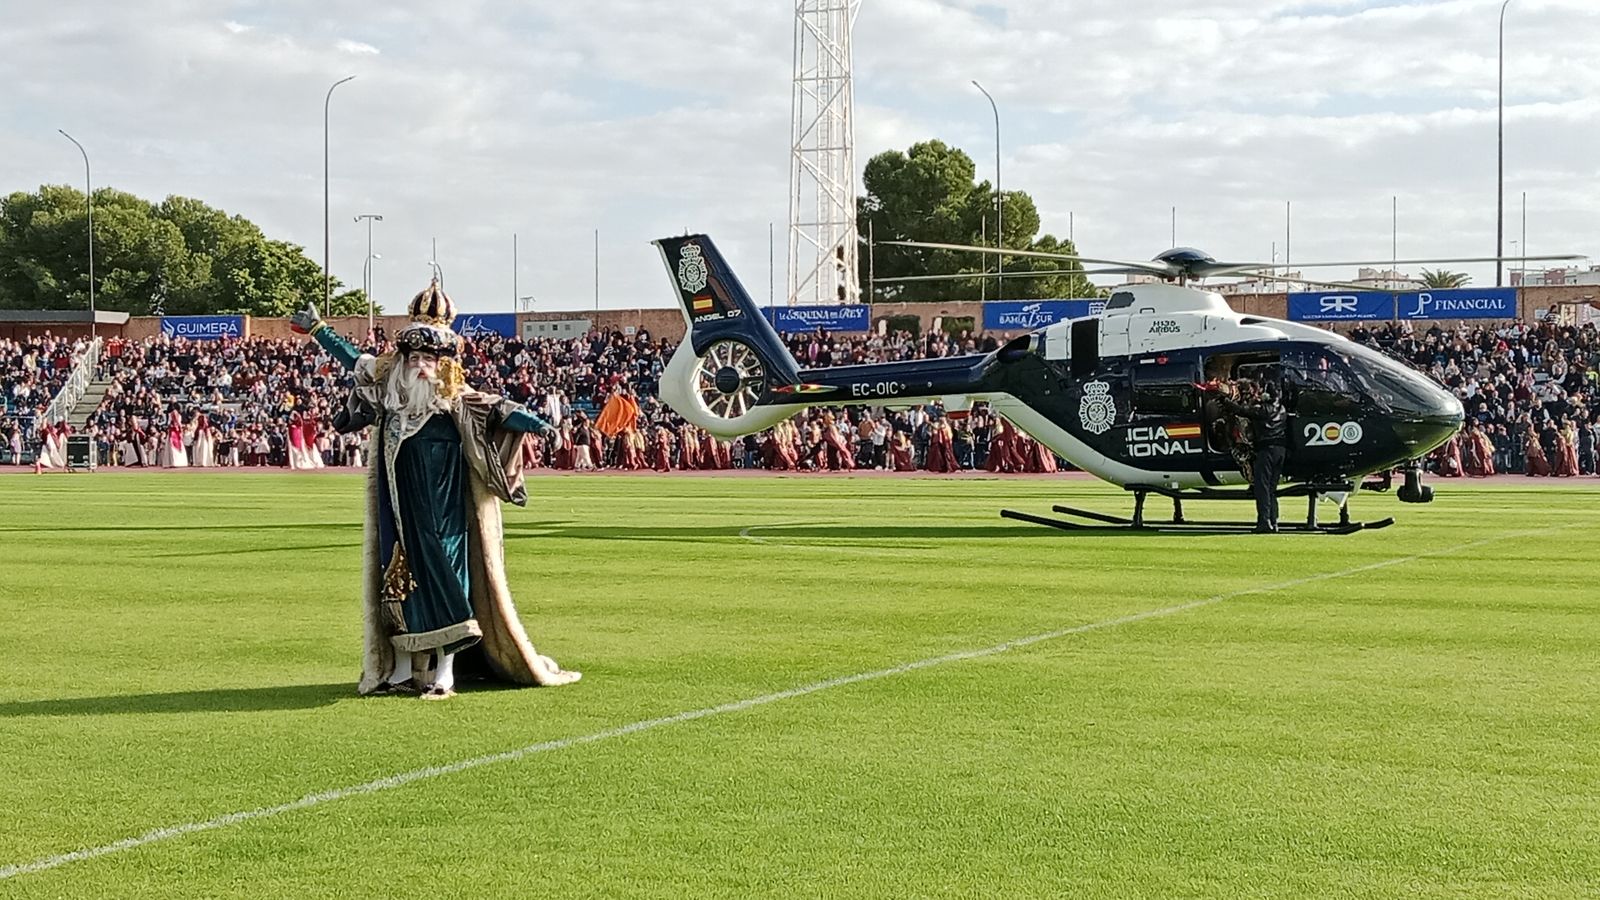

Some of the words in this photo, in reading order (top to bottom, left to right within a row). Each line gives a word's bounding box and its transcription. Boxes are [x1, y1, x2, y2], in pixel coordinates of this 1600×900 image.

[1434, 299, 1506, 311] FINANCIAL
[727, 309, 741, 318] 07
[1036, 315, 1053, 323] SUR
[176, 320, 238, 334] GUIMERÁ
[852, 381, 899, 396] EC-OIC
[1303, 421, 1363, 446] 200
